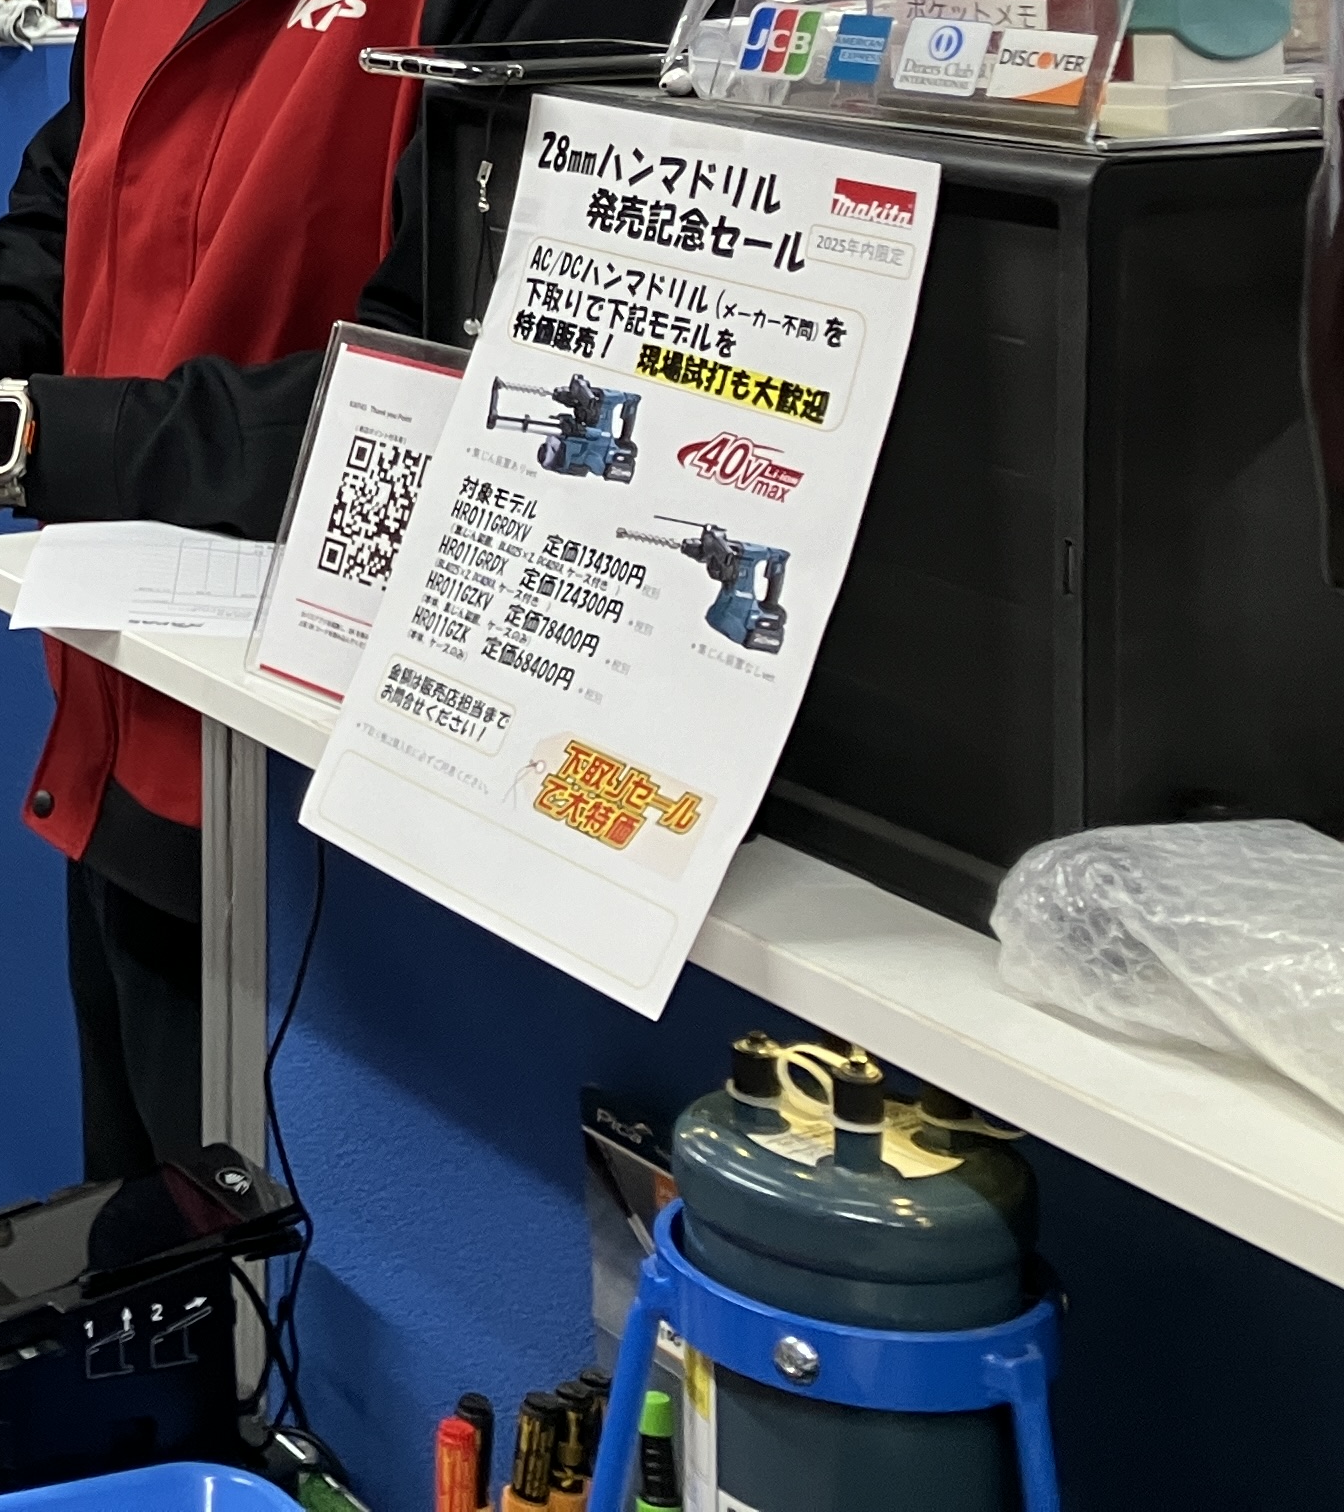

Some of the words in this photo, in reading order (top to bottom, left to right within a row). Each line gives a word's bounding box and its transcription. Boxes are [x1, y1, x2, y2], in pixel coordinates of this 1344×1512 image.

[745, 29, 812, 55] JCB
[999, 49, 1087, 74] DISCOVER
[538, 131, 781, 216] 28mmハンマドリル
[585, 187, 806, 273] 発売記念セール
[815, 234, 906, 267] 2025年内限定
[525, 277, 737, 358] 下取りで下記モデルを
[635, 344, 832, 425] 現場試打も大歓迎
[459, 475, 538, 520] 対象モデル
[752, 478, 790, 503] max
[542, 534, 647, 589] 定価134300円
[519, 567, 624, 624] 定価124300円
[411, 605, 472, 644] HR011GZK
[480, 636, 576, 691] 定価68400円
[503, 603, 600, 658] 定価78400円
[386, 662, 512, 730] 金額は販売店担当まで
[533, 772, 647, 851] で大特価
[560, 739, 702, 835] 下取りセール
[83, 1320, 95, 1340] 1
[150, 1302, 164, 1323] 2
